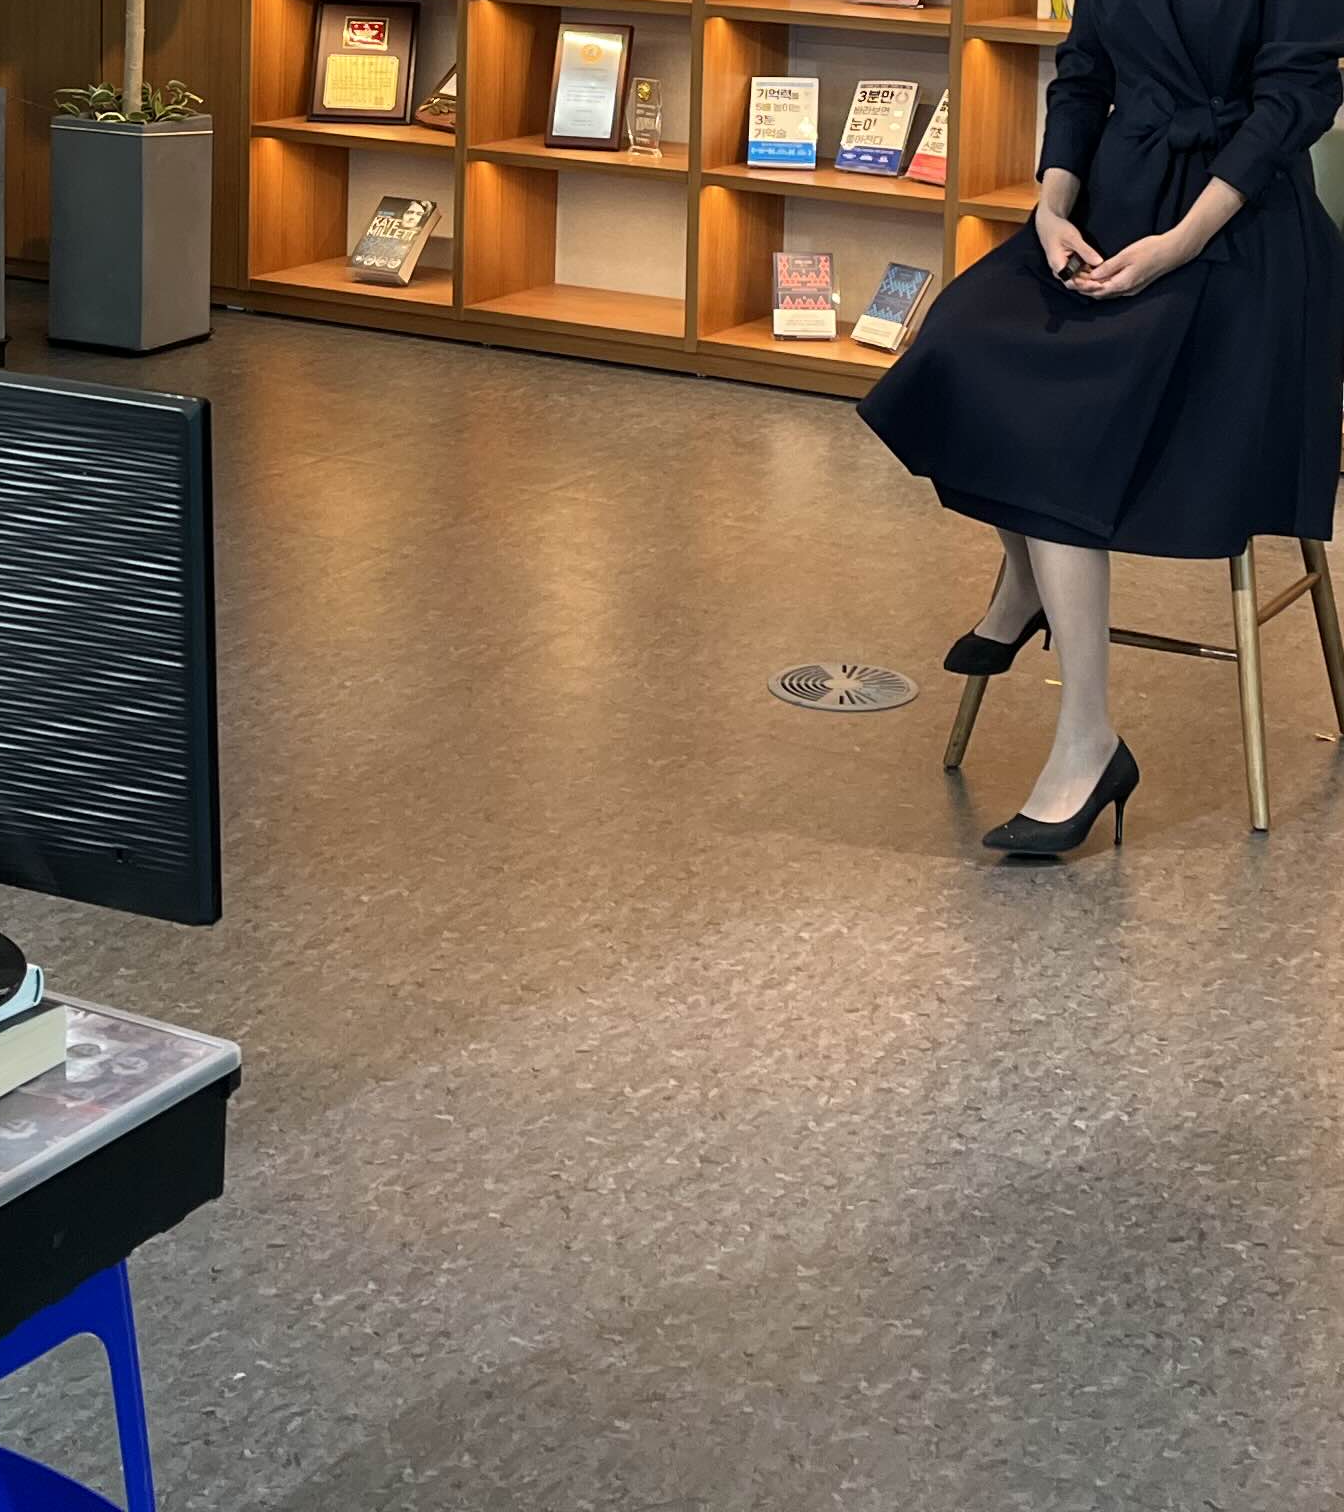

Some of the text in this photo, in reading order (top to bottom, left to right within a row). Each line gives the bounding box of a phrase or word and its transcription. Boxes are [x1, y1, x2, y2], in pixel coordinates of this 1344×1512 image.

[857, 90, 895, 104] 3분만
[849, 118, 878, 131] 눈이
[370, 216, 403, 229] KATE
[367, 226, 420, 240] MILLETT
